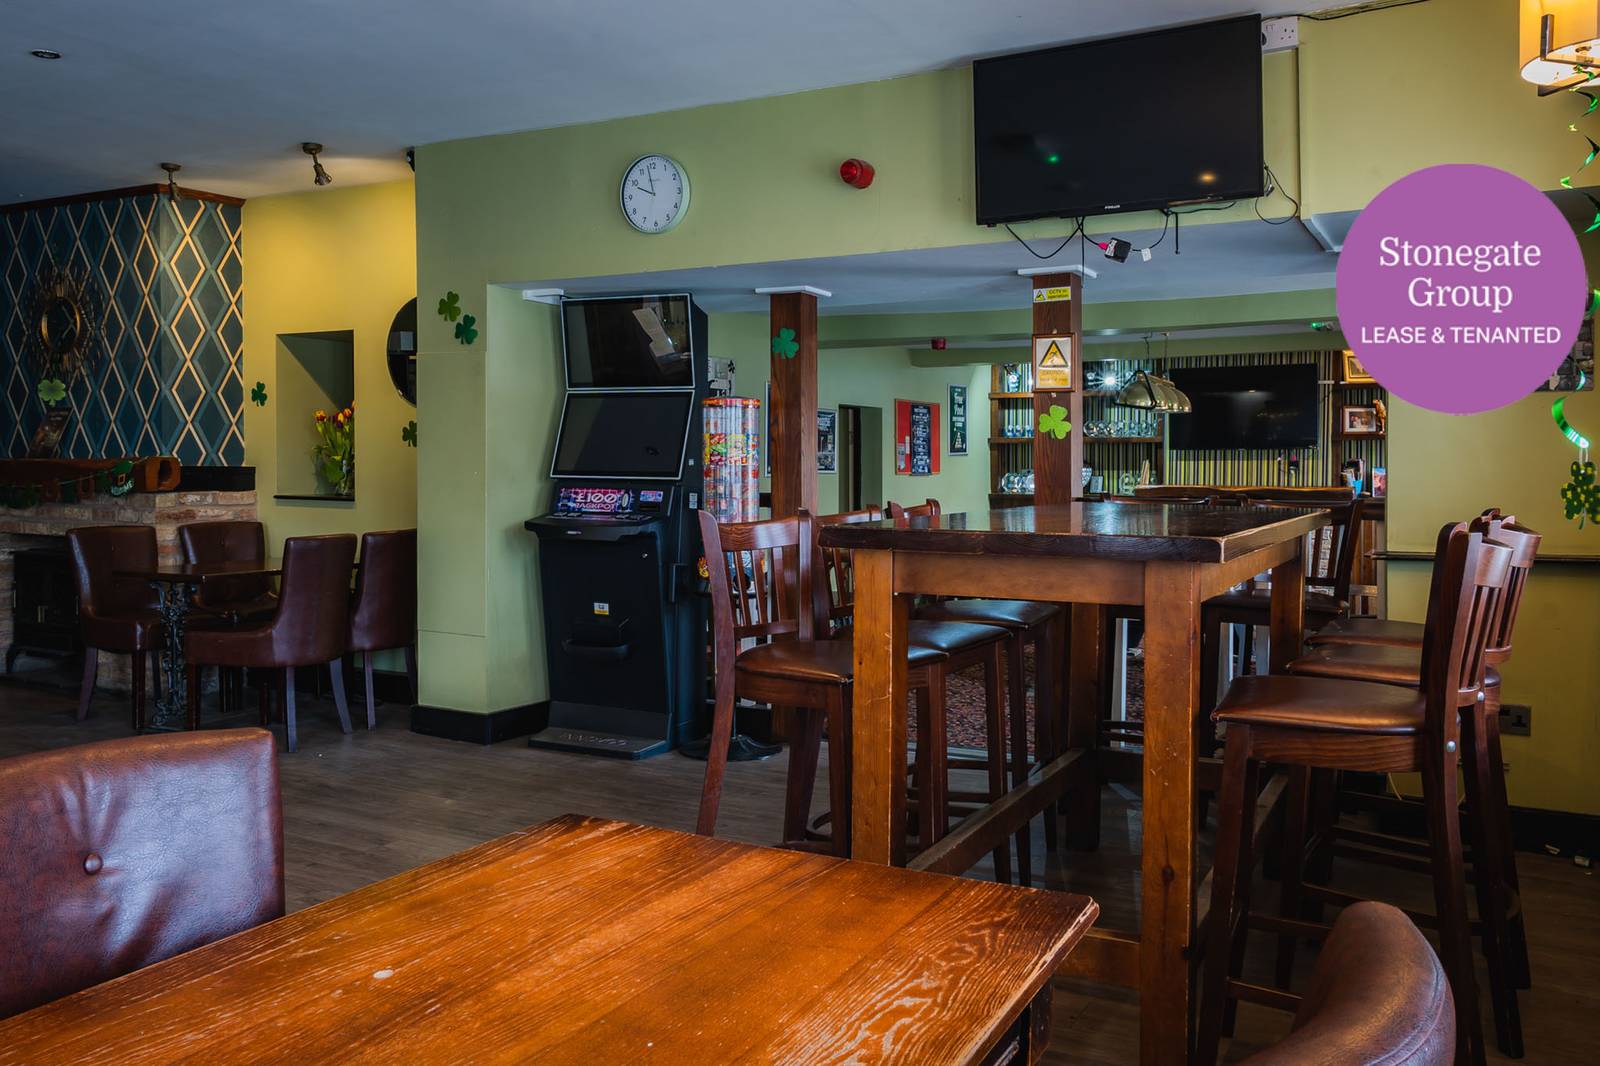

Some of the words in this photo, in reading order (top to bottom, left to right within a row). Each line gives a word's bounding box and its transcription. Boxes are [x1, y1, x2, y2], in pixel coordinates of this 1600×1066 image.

[649, 162, 656, 170] 12
[664, 164, 667, 172] 1
[672, 173, 677, 181] 2
[632, 179, 638, 187] 10
[677, 187, 682, 195] 3
[666, 214, 670, 222] 5
[576, 493, 617, 503] £100
